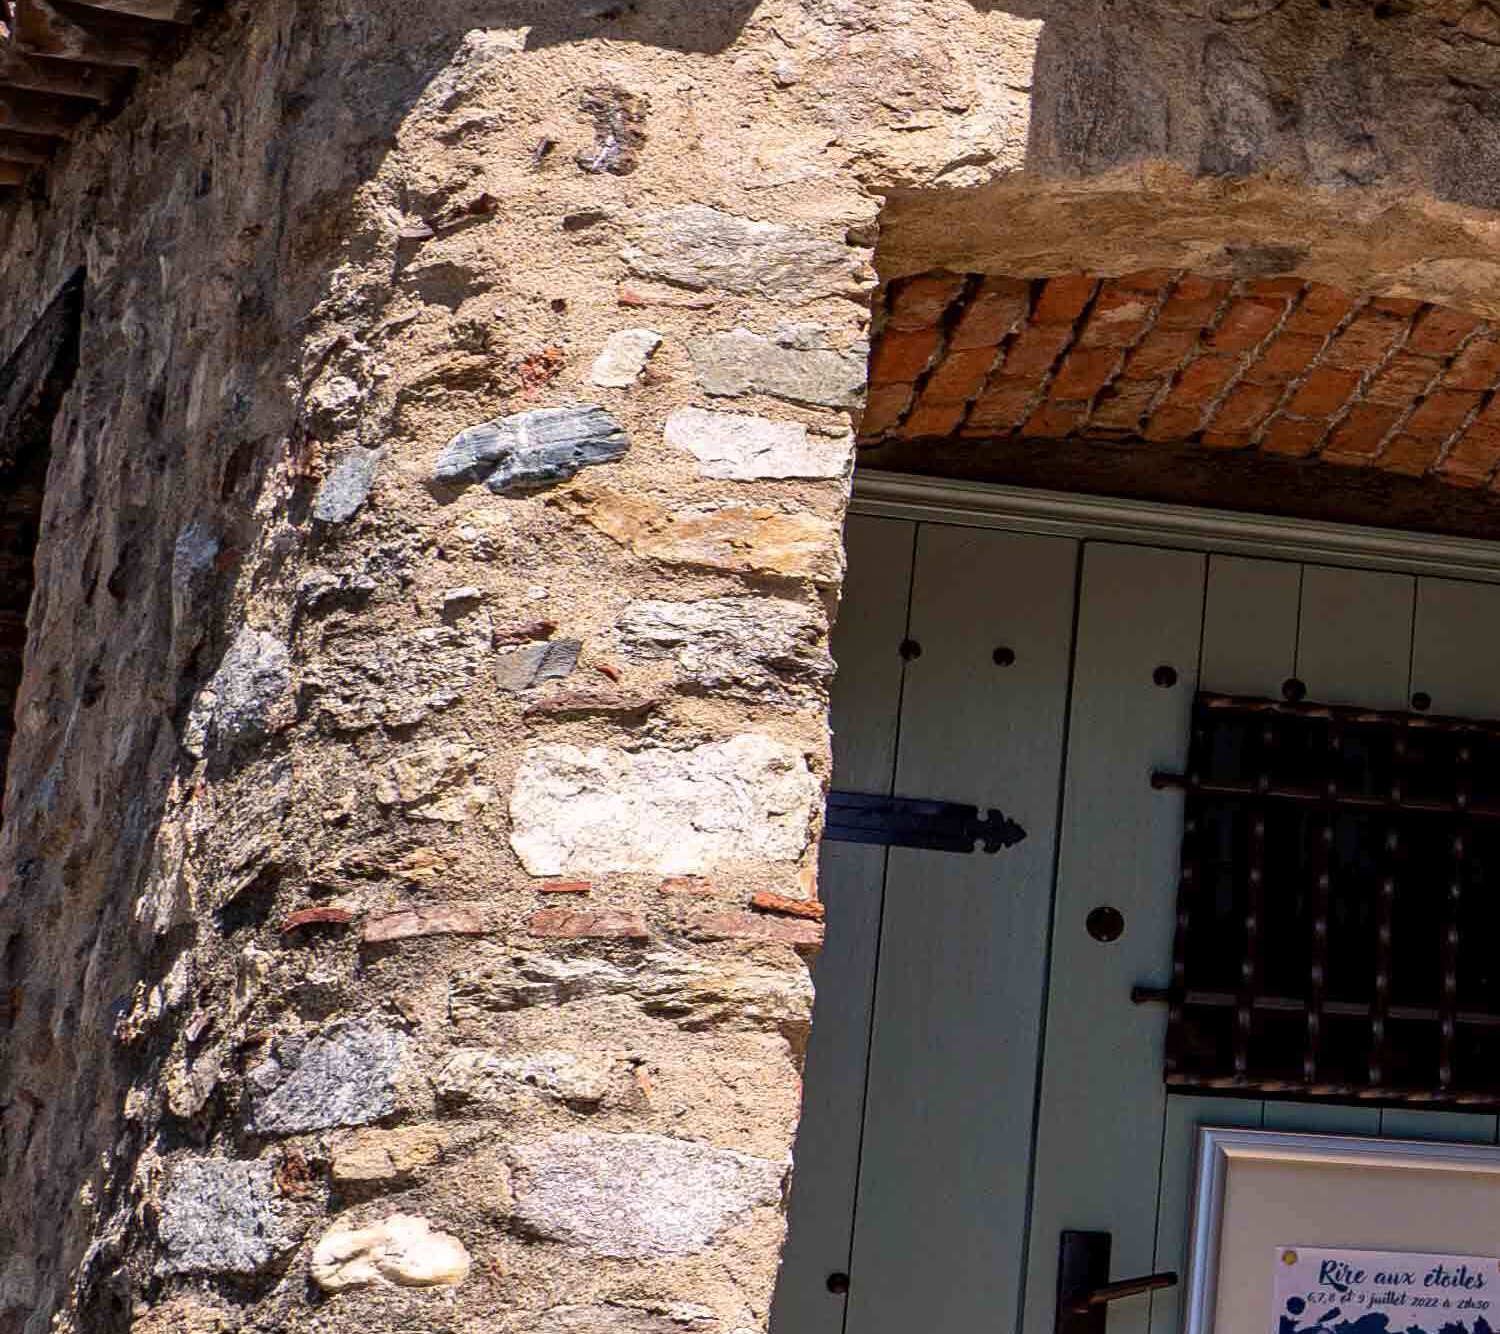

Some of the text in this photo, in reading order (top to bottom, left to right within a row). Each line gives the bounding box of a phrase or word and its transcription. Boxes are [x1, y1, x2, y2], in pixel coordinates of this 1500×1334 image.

[1318, 1259, 1368, 1291] Rire
[1373, 1271, 1416, 1286] aux
[1367, 1291, 1408, 1309] juillet
[1411, 1296, 1440, 1309] 2022
